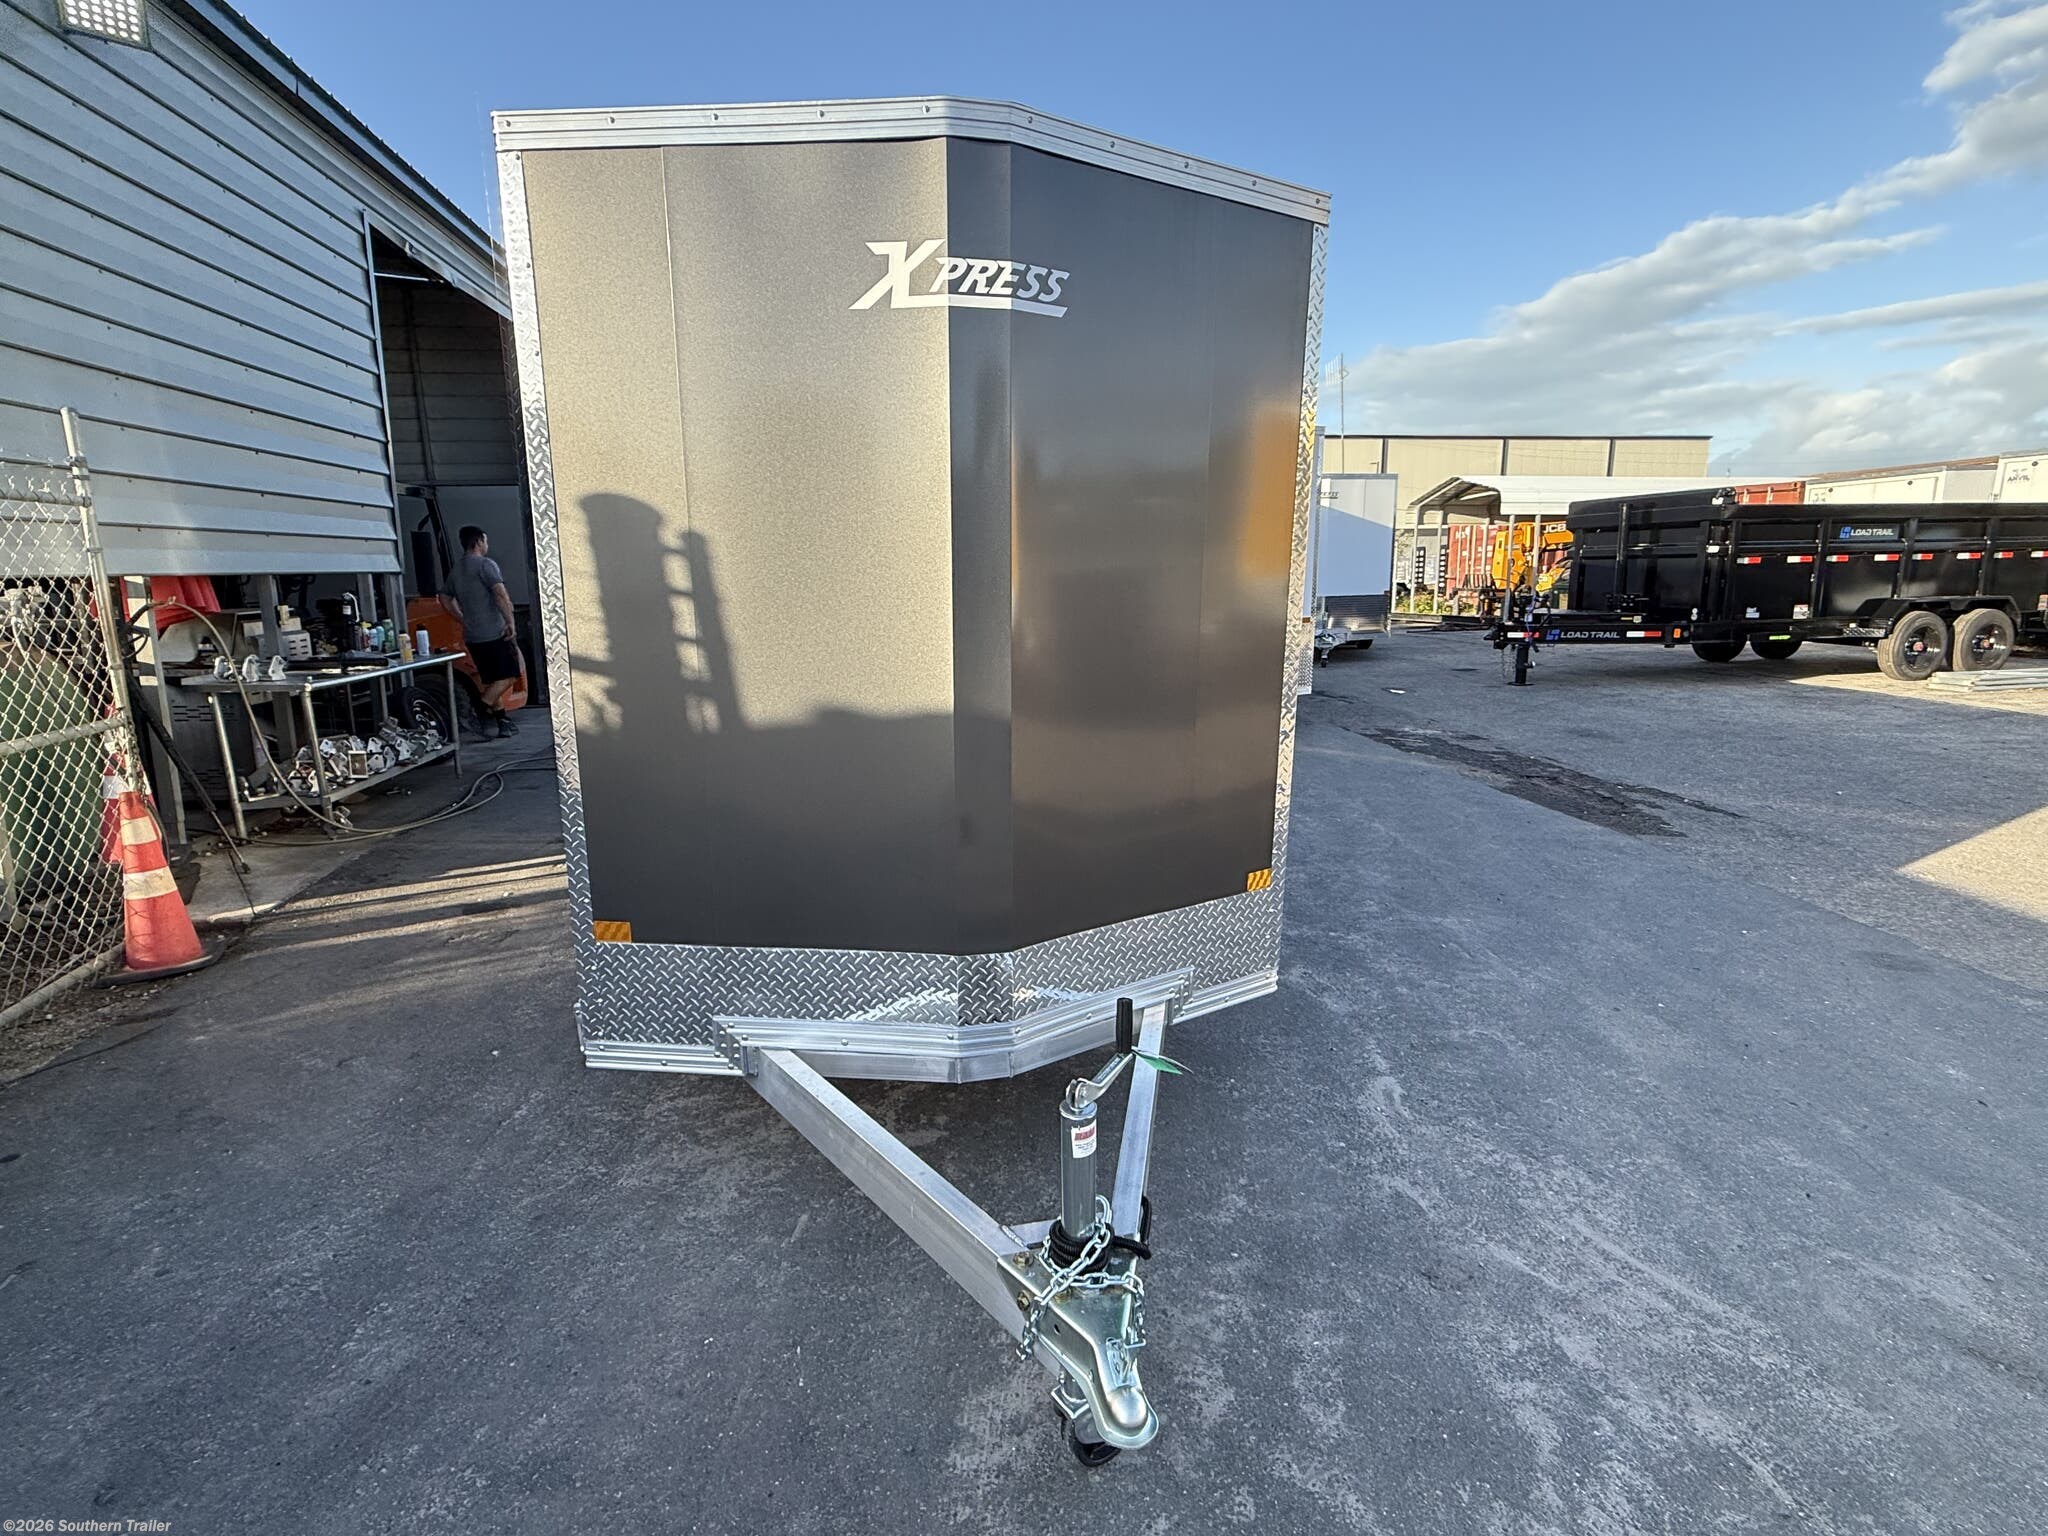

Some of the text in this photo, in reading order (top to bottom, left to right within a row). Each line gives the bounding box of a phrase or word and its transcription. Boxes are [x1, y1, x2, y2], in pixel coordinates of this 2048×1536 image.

[848, 238, 1070, 313] XPRESS
[1543, 524, 1567, 533] JCB
[1850, 528, 1894, 536] LOAD TRAIL
[1560, 631, 1620, 639] LOAD TRAIL
